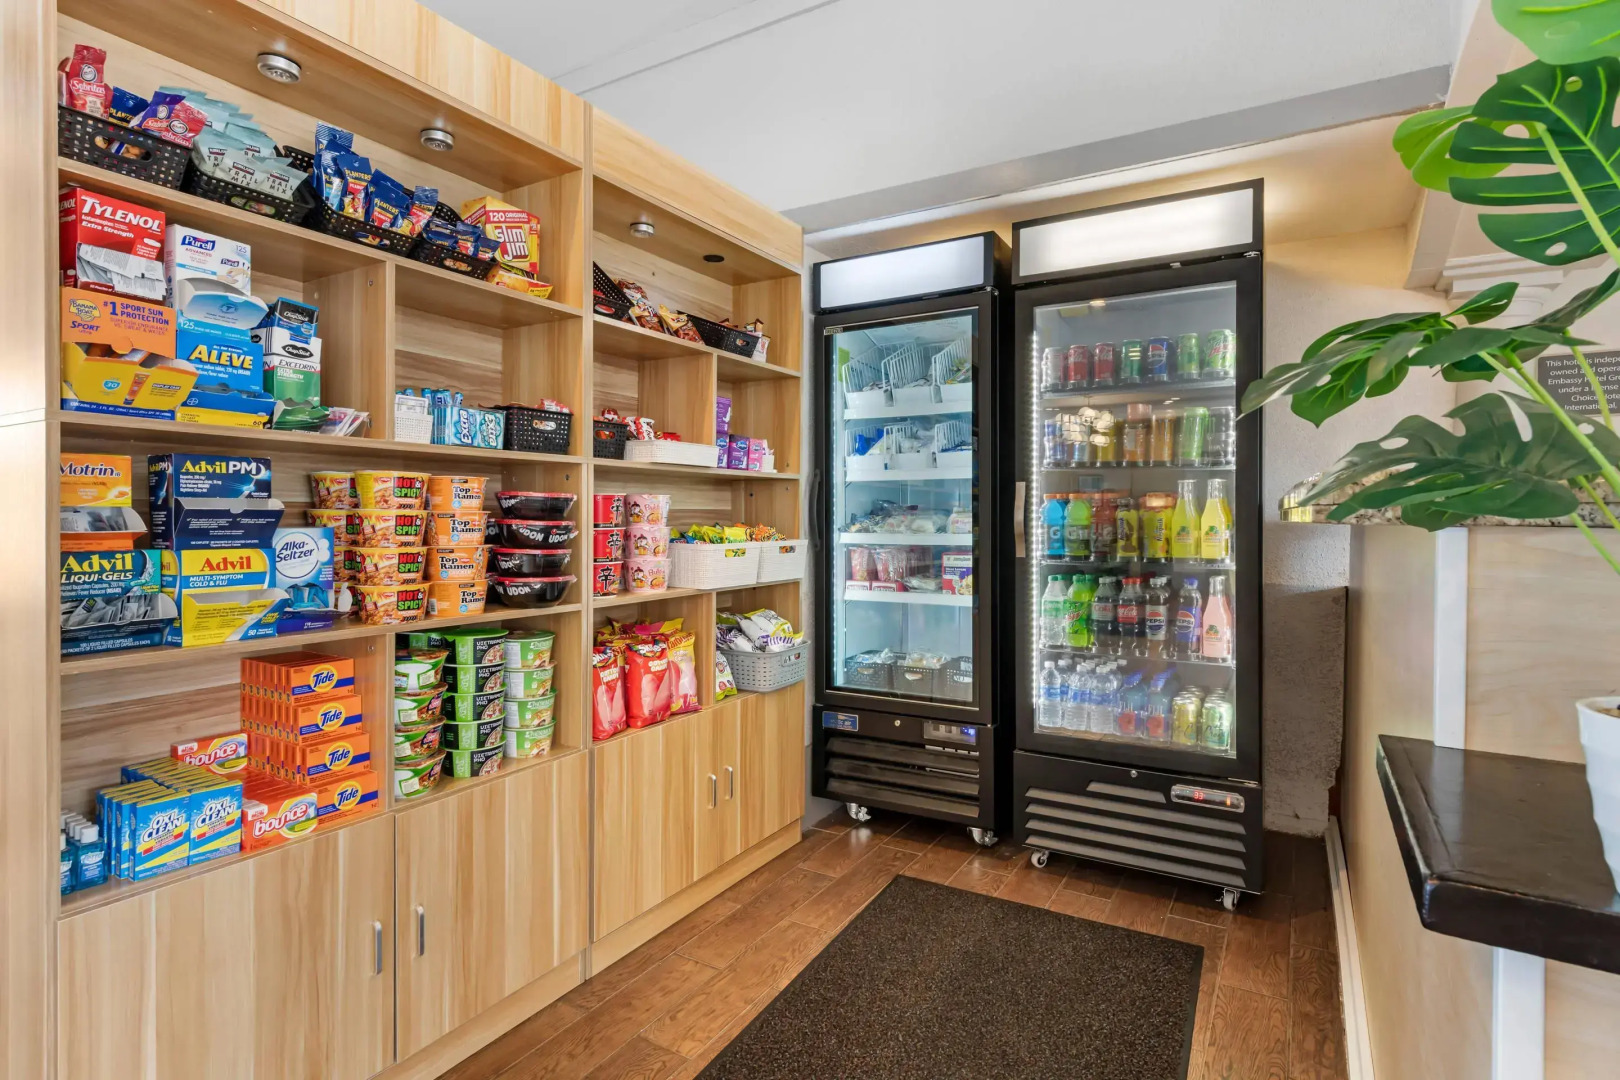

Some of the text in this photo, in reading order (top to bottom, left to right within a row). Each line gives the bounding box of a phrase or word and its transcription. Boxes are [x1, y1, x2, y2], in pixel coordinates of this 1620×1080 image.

[227, 167, 259, 184] TRAIL
[344, 167, 372, 181] PLANTERS
[231, 176, 251, 187] MIX
[266, 177, 294, 191] TRAIL
[269, 184, 287, 194] MIX
[81, 195, 163, 232] TYLENOL
[374, 198, 400, 215] PLANTERS
[488, 212, 506, 222] 120
[81, 220, 135, 239] Extra Strength
[235, 244, 248, 254] 125
[120, 302, 146, 314] SPORT
[147, 307, 164, 317] SUN
[120, 310, 170, 326] PROTECTION
[180, 320, 195, 330] 125
[123, 323, 143, 332] SWEAT
[138, 321, 169, 332] ENDURANCE
[188, 344, 254, 370] ALEVE
[278, 359, 318, 371] EXCEDRIN
[1549, 367, 1578, 376] owned
[1579, 366, 1596, 374] ad
[1547, 377, 1583, 385] Embassy
[59, 462, 116, 477] Motrin
[181, 459, 257, 475] Advil PM
[453, 485, 471, 494] Top
[453, 492, 482, 500] Ramen
[611, 497, 625, 520] 辛
[450, 518, 470, 527] Top
[450, 525, 483, 533] Ramen
[519, 526, 545, 542] UDON
[548, 534, 568, 543] UDON
[1049, 526, 1060, 539] G
[278, 540, 309, 553] Alka-
[607, 532, 623, 550] 辛
[60, 552, 134, 573] Advil
[275, 548, 315, 563] Seltzer
[439, 556, 459, 565] Top
[200, 555, 252, 572] Advil
[440, 562, 474, 570] Ramen
[189, 573, 244, 582] MULTI-SYMPTOM
[597, 565, 616, 591] 辛
[460, 590, 477, 598] Top
[506, 585, 532, 596] UDON
[460, 595, 486, 604] Ramen
[114, 637, 134, 645] CAPSULES
[312, 671, 335, 689] Tide
[320, 709, 343, 727] Tide
[184, 742, 238, 767] bounce
[328, 748, 351, 767] Tide
[337, 787, 359, 807] Tide
[1193, 791, 1204, 800] 33
[204, 797, 230, 816] OXI
[151, 809, 177, 829] OXI
[195, 802, 238, 829] CLEAN
[253, 803, 309, 839] bounce
[142, 814, 186, 843] CLEAN
